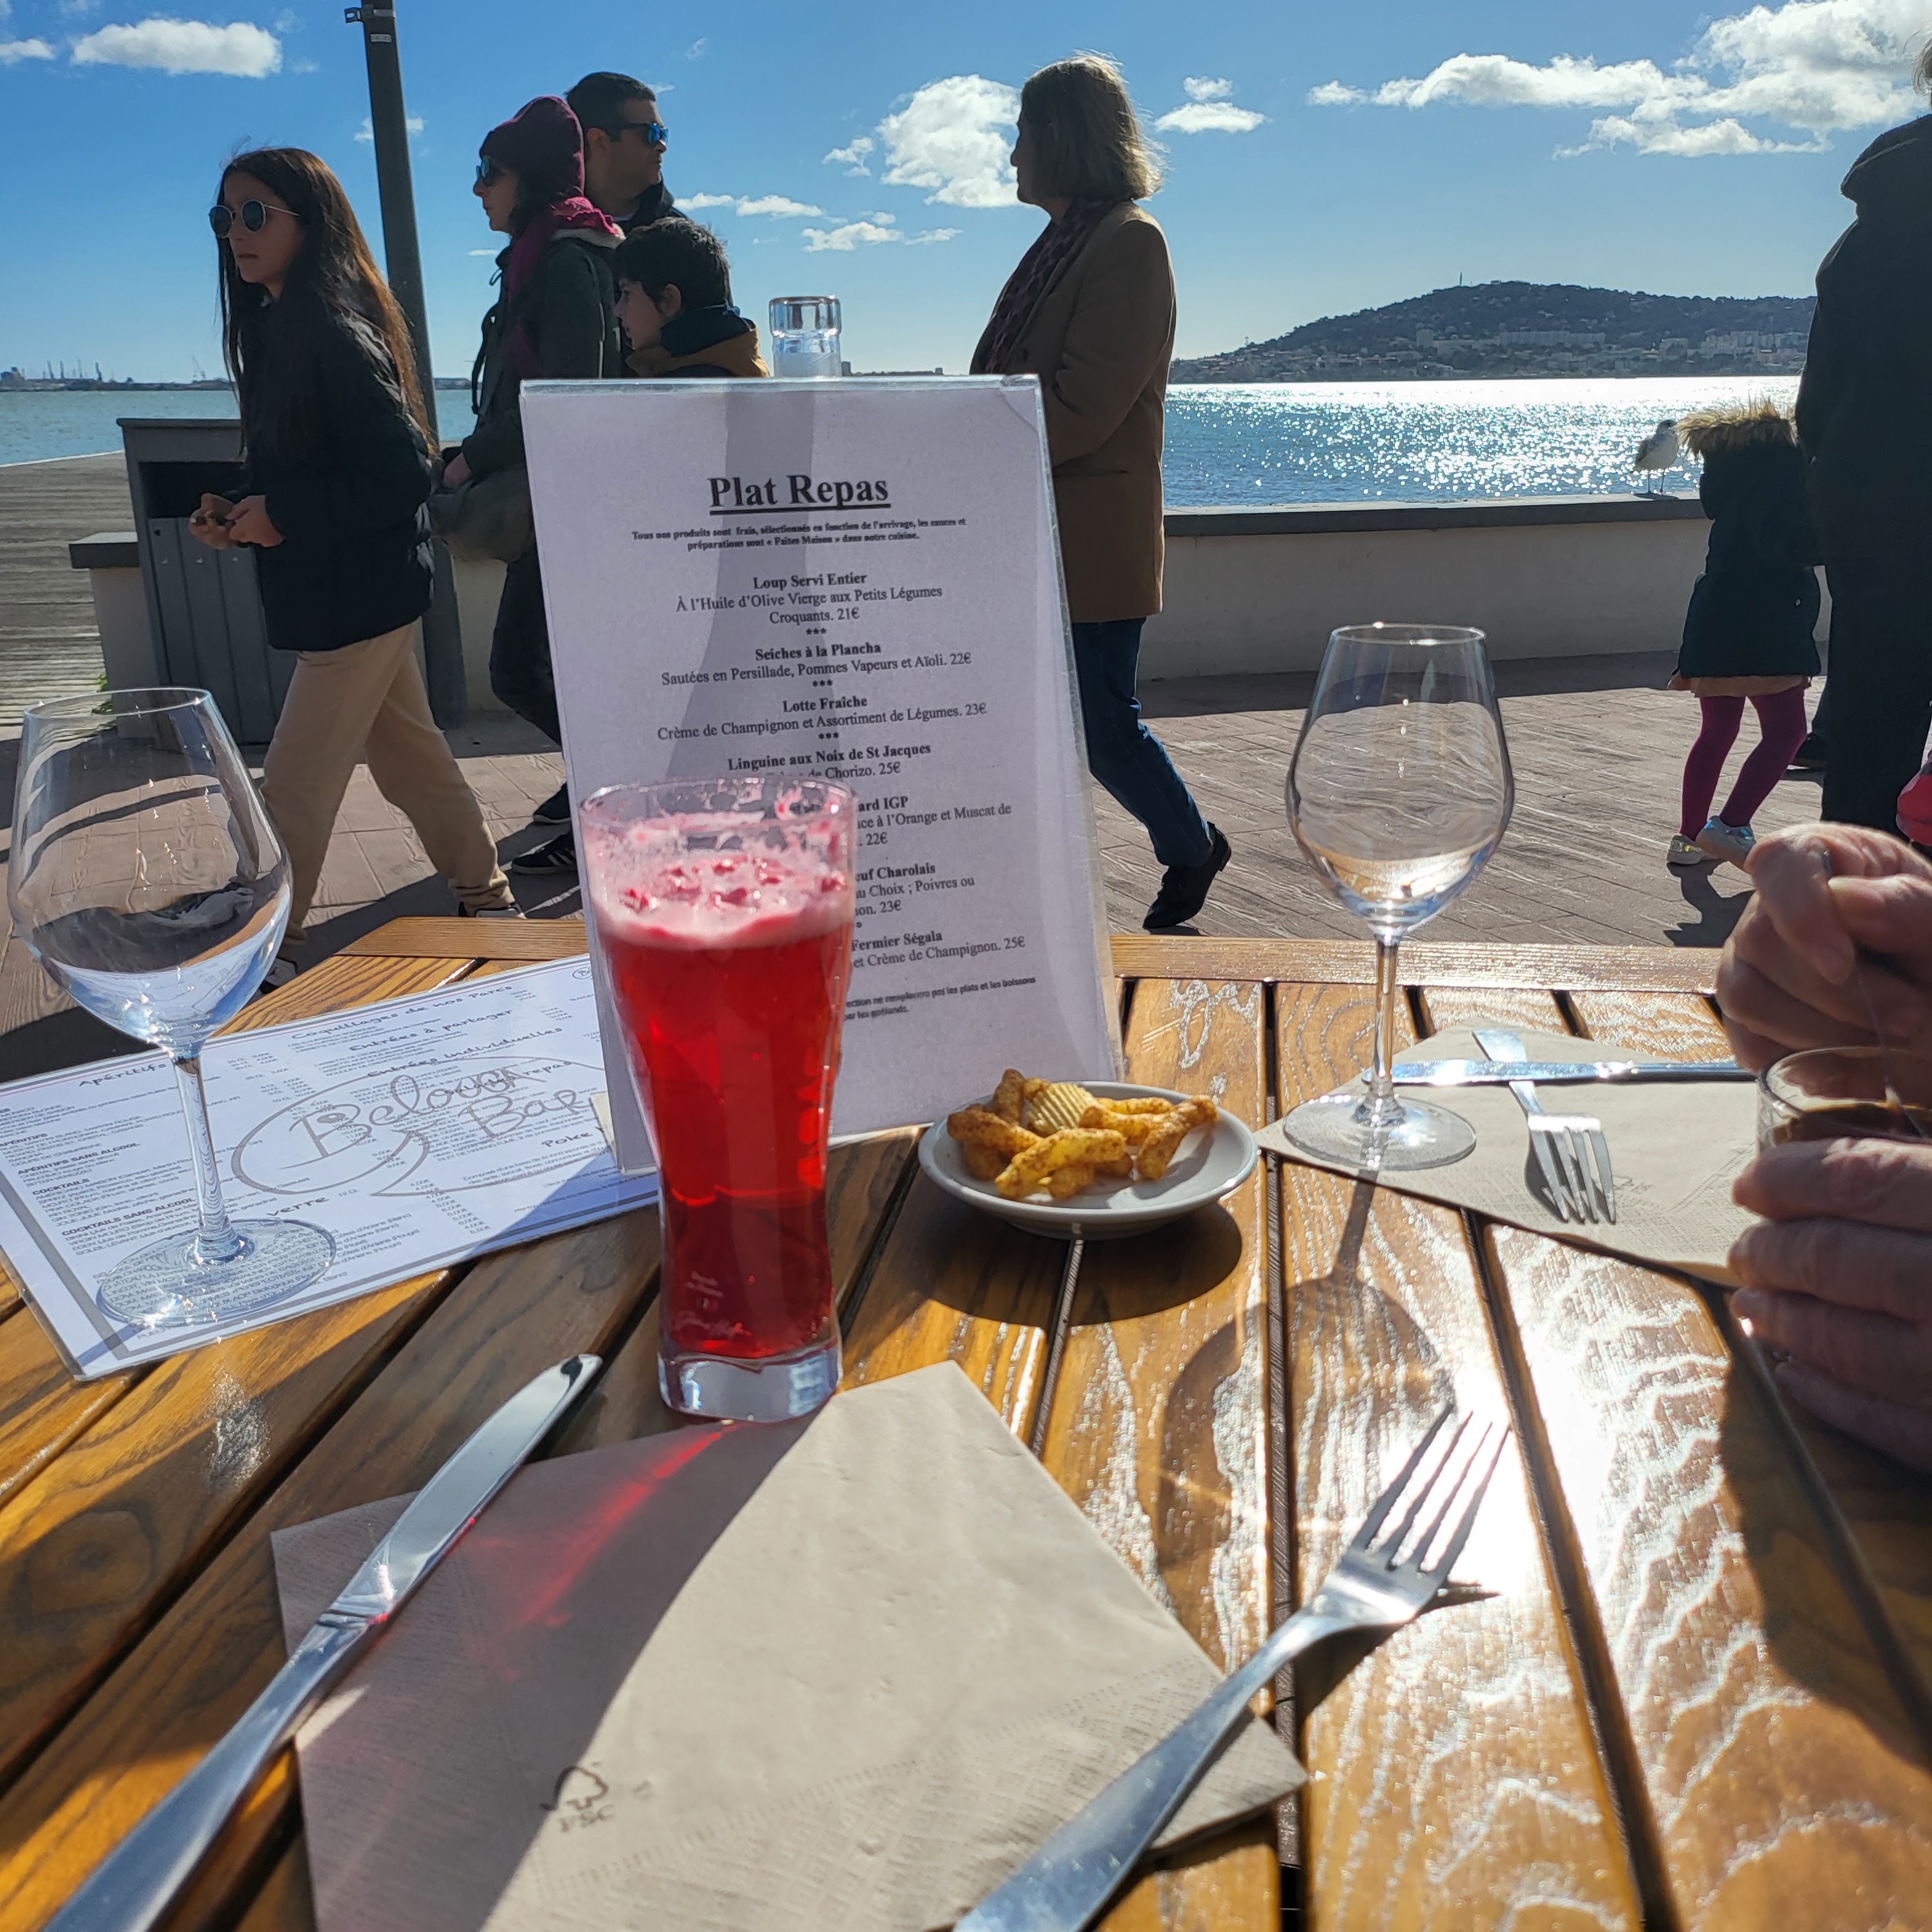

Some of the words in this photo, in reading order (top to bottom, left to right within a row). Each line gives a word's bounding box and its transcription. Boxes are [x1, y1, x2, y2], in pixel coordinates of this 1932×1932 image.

[706, 476, 778, 508] Plat
[786, 475, 889, 511] Repas
[632, 531, 653, 540] Tous
[673, 529, 711, 541] produits
[713, 528, 731, 537] sont
[825, 522, 859, 531] fonction
[861, 520, 871, 529] de
[918, 519, 928, 527] les
[958, 518, 967, 526] et
[687, 541, 744, 551] préparations
[774, 537, 801, 546] Faites
[801, 535, 833, 544] Maison
[842, 535, 862, 543] dans
[889, 532, 920, 540] cuisine.
[753, 577, 787, 591] Loup
[791, 573, 824, 588] Servi
[827, 571, 868, 586] Entier
[676, 595, 688, 612] À
[787, 592, 827, 607] Vierge
[830, 593, 852, 603] aux
[854, 588, 887, 602] Petits
[890, 586, 943, 602] Légumes
[769, 611, 834, 626] Croquants.
[837, 606, 861, 621] 21€
[755, 647, 802, 661] Seiches
[805, 646, 813, 658] à
[816, 645, 828, 657] la
[831, 642, 881, 656] Plancha
[661, 670, 710, 686] Sautées
[713, 672, 728, 682] en
[730, 664, 795, 681] Persillade,
[797, 663, 848, 675] Pommes
[850, 659, 898, 675] Vapeurs
[901, 658, 912, 669] et
[914, 653, 948, 668] Aïoli.
[949, 652, 972, 665] 22€
[782, 700, 817, 713] Lotte
[819, 695, 868, 710] Fraîche
[657, 726, 700, 741] Crème
[703, 723, 718, 737] de
[721, 719, 799, 736] Champignon
[802, 717, 814, 728] et
[816, 712, 888, 728] Assortiment
[889, 710, 904, 722] de
[906, 706, 963, 723] Légumes.
[965, 702, 987, 716] 23€
[728, 755, 786, 772] Linguine
[789, 754, 812, 765] aux
[815, 749, 845, 763] Noix
[848, 748, 864, 761] de
[866, 746, 880, 759] St
[882, 745, 931, 759] Jacques
[825, 765, 876, 779] Chorizo.
[878, 761, 901, 775] 25€
[858, 798, 880, 812] ard
[883, 796, 909, 810] IGP
[877, 814, 884, 828] à
[940, 809, 952, 821] et
[954, 805, 996, 820] Muscat
[998, 803, 1012, 816] de
[865, 831, 888, 847] 22€
[855, 867, 874, 883] euf
[876, 861, 936, 880] Charolais
[869, 882, 905, 898] Choix
[914, 878, 958, 893] Poivres
[960, 876, 976, 887] ou
[879, 899, 902, 913] 23€
[852, 936, 901, 952] Fermier
[903, 930, 943, 947] Ségala
[854, 957, 865, 969] et
[867, 951, 907, 967] Crème
[909, 949, 923, 961] de
[925, 941, 1002, 960] Champignon.
[1003, 935, 1026, 949] 25€
[947, 985, 958, 995] les
[960, 983, 980, 996] plats
[980, 981, 989, 991] et
[990, 980, 1002, 989] les
[1002, 976, 1036, 987] boissons
[291, 1012, 398, 1040] Coquillages
[405, 1005, 428, 1014] de
[432, 997, 464, 1008] nos
[468, 985, 513, 999] Parcs
[857, 1011, 870, 1019] les
[349, 1032, 418, 1052] Entrées
[424, 1025, 437, 1034] à
[442, 1009, 513, 1033] partager
[367, 1057, 438, 1078] Entrées
[443, 1027, 564, 1059] individuelles
[78, 1062, 167, 1087] Apéritifs
[522, 1060, 573, 1076] repas
[540, 1131, 593, 1147] Poke
[18, 1159, 70, 1175] APÉRITIFS
[70, 1152, 99, 1162] SANS
[101, 1142, 141, 1155] ALCOOL
[32, 1178, 90, 1195] COCKTAILS
[61, 1217, 121, 1236] COCKTAILS
[123, 1208, 154, 1220] SANS
[155, 1198, 196, 1211] ALCOOL
[265, 1197, 330, 1216] verre
